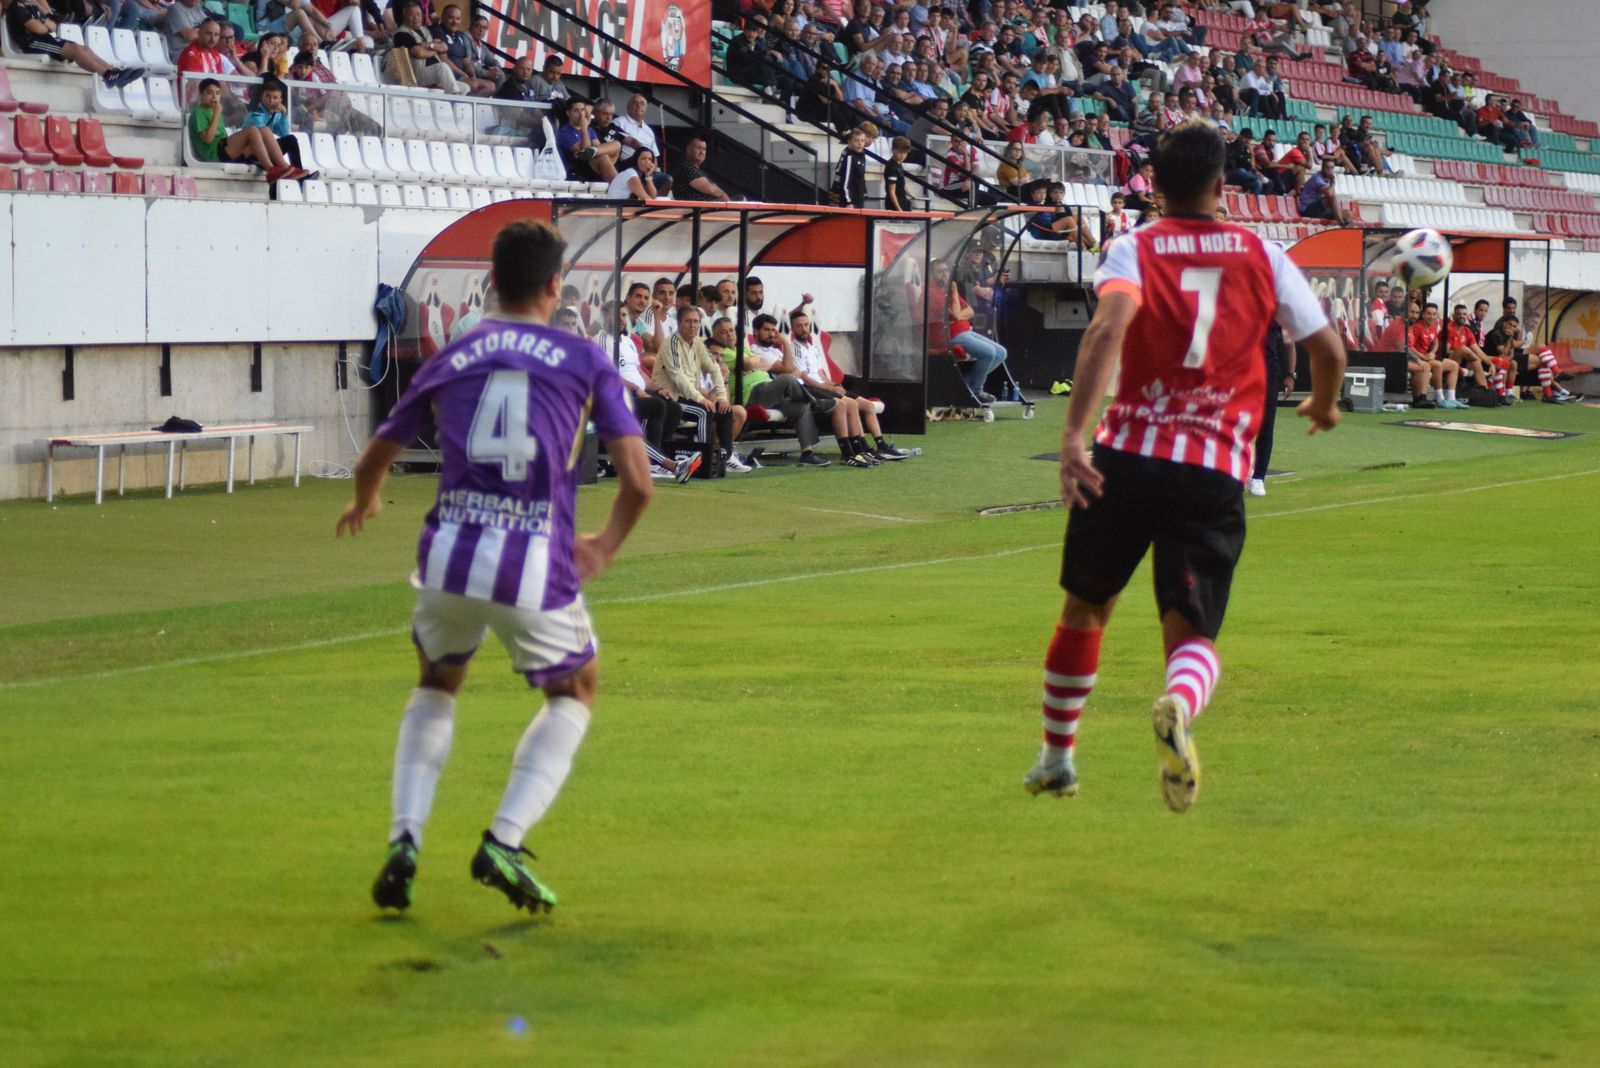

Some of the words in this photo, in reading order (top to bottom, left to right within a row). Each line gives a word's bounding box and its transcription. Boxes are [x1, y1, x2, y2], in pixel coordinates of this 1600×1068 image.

[1153, 234, 1195, 255] DANI
[450, 330, 567, 371] D.TORRES
[1181, 267, 1223, 368] 7
[466, 369, 537, 481] 4
